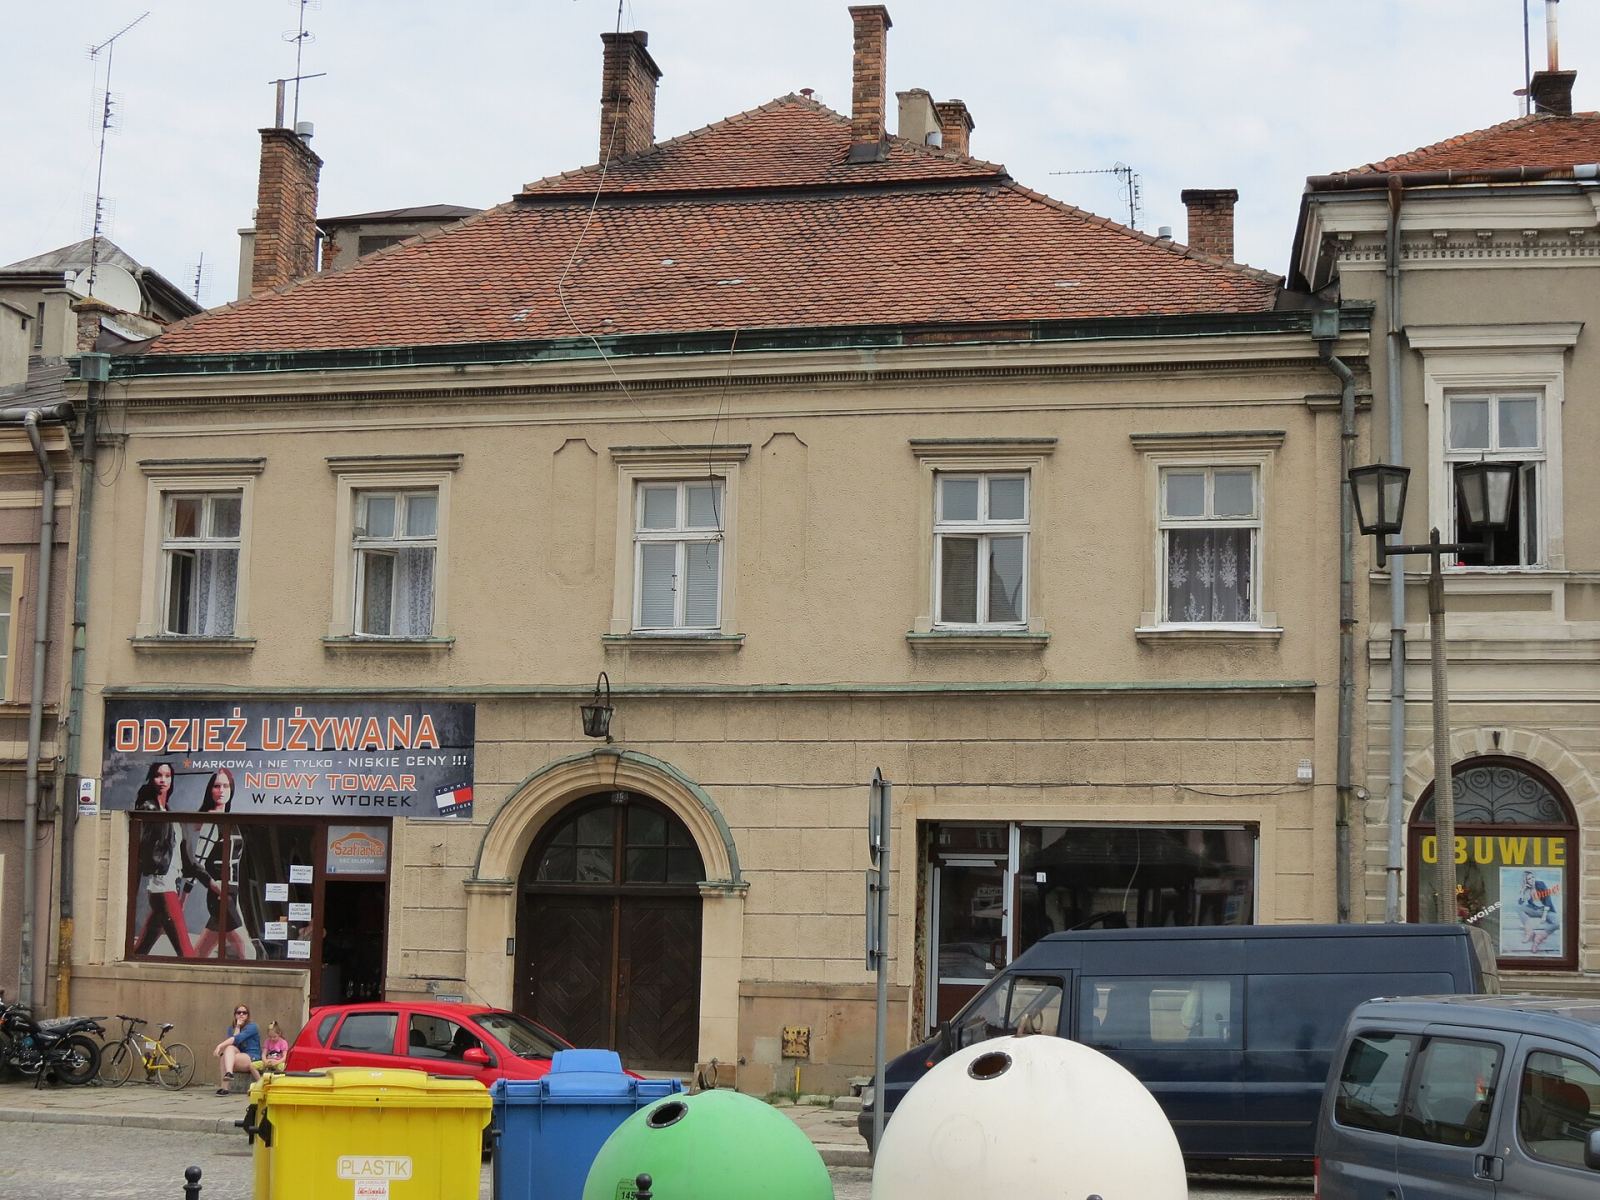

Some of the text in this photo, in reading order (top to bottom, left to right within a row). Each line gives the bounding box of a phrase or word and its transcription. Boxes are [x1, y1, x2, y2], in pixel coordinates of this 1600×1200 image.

[115, 707, 440, 752] ODZIEŻ UŻYWANA
[192, 760, 253, 769] MARKOWA
[267, 760, 288, 768] NIE
[294, 760, 333, 768] TYLKO
[348, 757, 400, 768] NISKIE
[406, 756, 447, 766] CENY
[244, 772, 417, 792] NOWY TOWAR
[252, 792, 412, 807] W KAŻDY WTOREK
[1422, 835, 1566, 866] OBUWIE
[1467, 901, 1503, 923] wojas
[341, 1160, 408, 1176] PLASTIK
